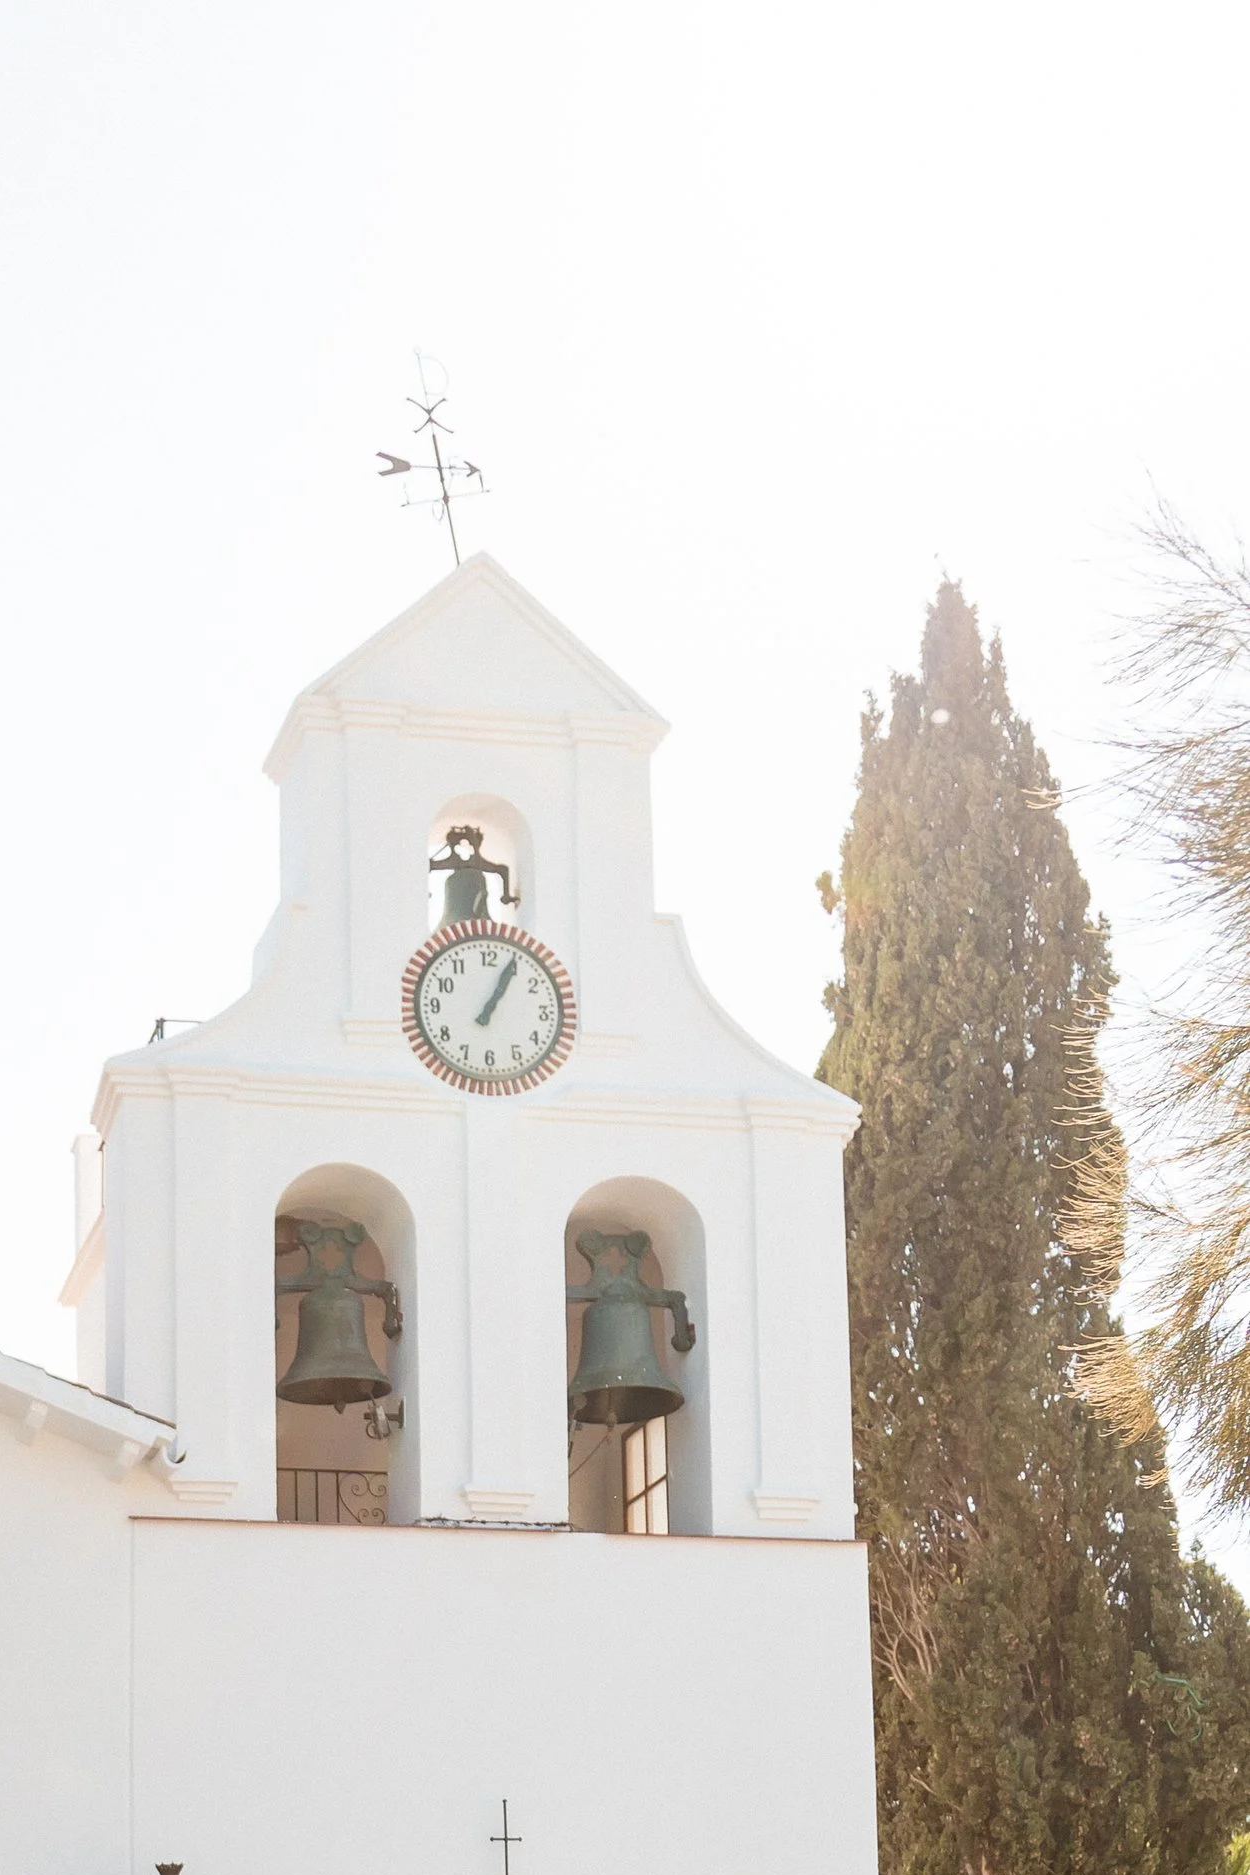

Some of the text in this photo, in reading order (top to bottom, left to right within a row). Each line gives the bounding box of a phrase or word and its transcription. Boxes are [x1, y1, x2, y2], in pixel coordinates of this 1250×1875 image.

[452, 959, 465, 975] 11
[480, 951, 498, 967] 12
[438, 977, 454, 993] 10
[528, 978, 539, 994] 2
[430, 998, 441, 1014] 9
[539, 1005, 549, 1022] 3
[440, 1026, 450, 1042] 8
[529, 1030, 539, 1046] 4
[459, 1045, 469, 1061] 7
[484, 1050, 495, 1067] 6
[512, 1045, 522, 1061] 5
